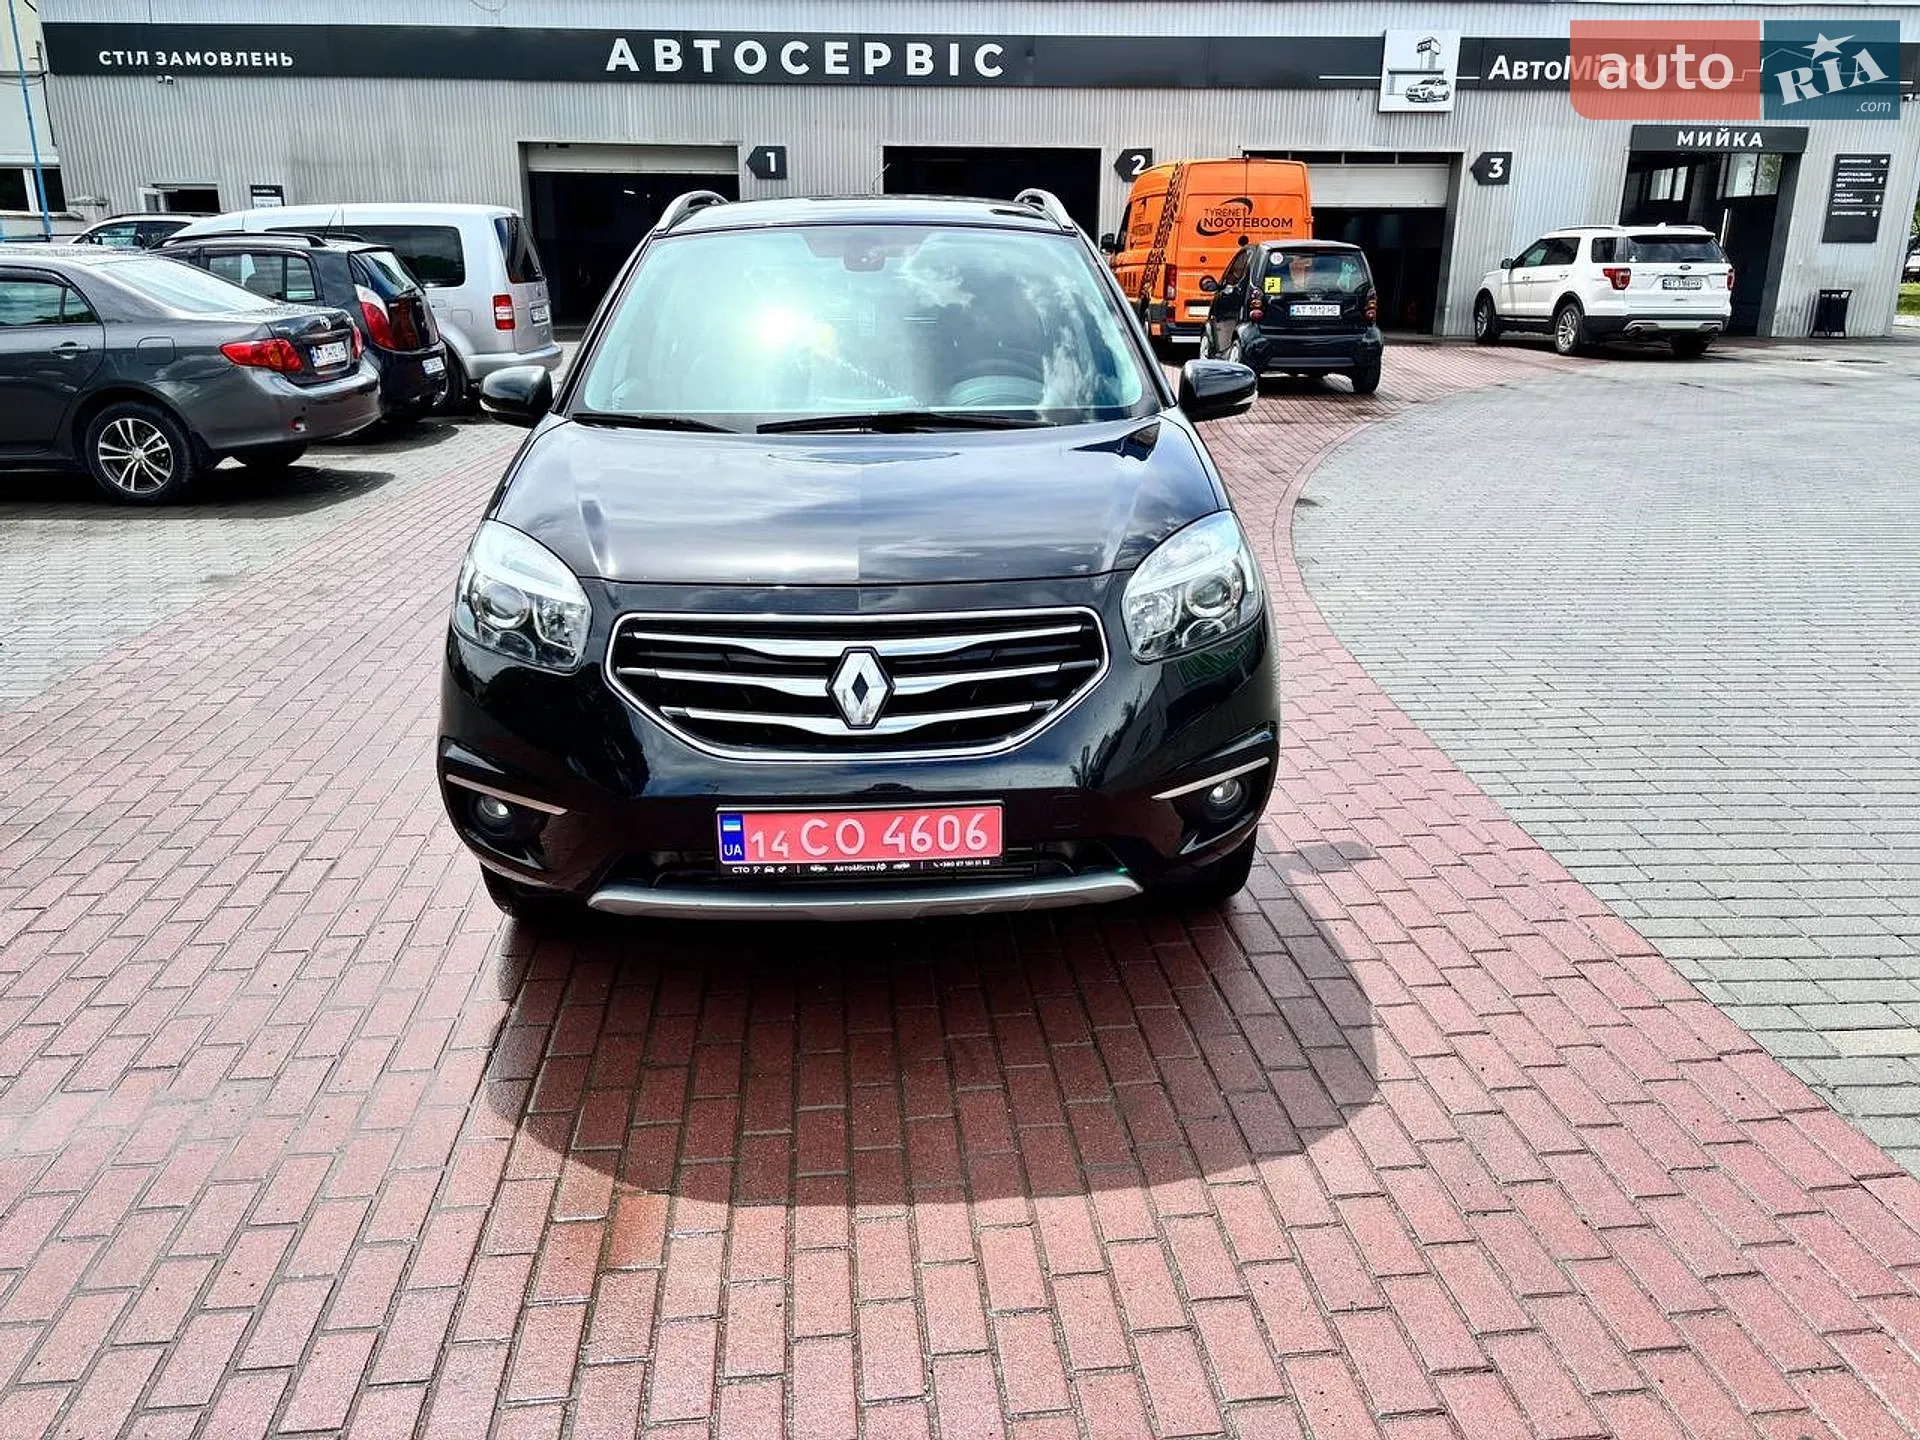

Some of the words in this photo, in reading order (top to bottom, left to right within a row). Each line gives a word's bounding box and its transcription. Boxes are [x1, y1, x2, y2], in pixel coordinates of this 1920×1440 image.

[99, 51, 149, 65] СТІЛ
[156, 51, 294, 66] ЗАМОВЛЕНЬ
[606, 38, 1004, 77] АВТОСЕРВІС
[1677, 127, 1763, 147] МИЙКА
[766, 151, 776, 172] 1
[1131, 154, 1146, 175] 2
[1488, 157, 1504, 178] 3
[1203, 217, 1293, 228] NOOTEBOOM
[751, 830, 790, 858] 14
[800, 817, 866, 857] CO
[882, 812, 989, 854] 4606
[724, 844, 743, 857] UA
